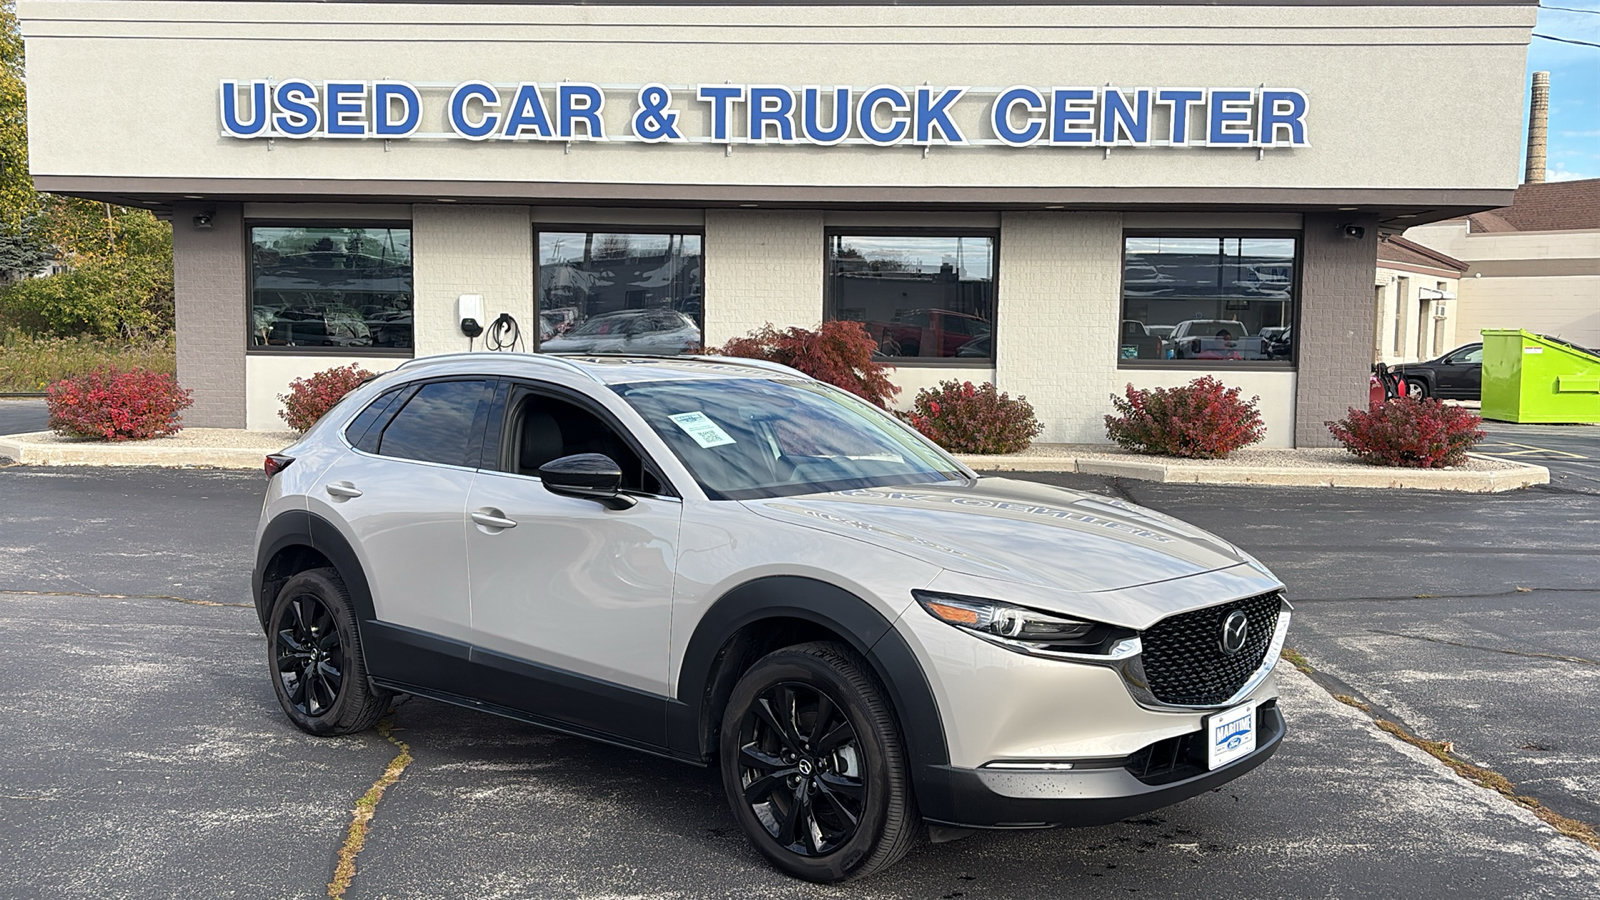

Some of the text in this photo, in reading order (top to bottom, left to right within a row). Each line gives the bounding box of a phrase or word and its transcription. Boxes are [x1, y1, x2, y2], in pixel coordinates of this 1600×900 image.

[219, 79, 1311, 149] USED CAR & TRUCK CENTER
